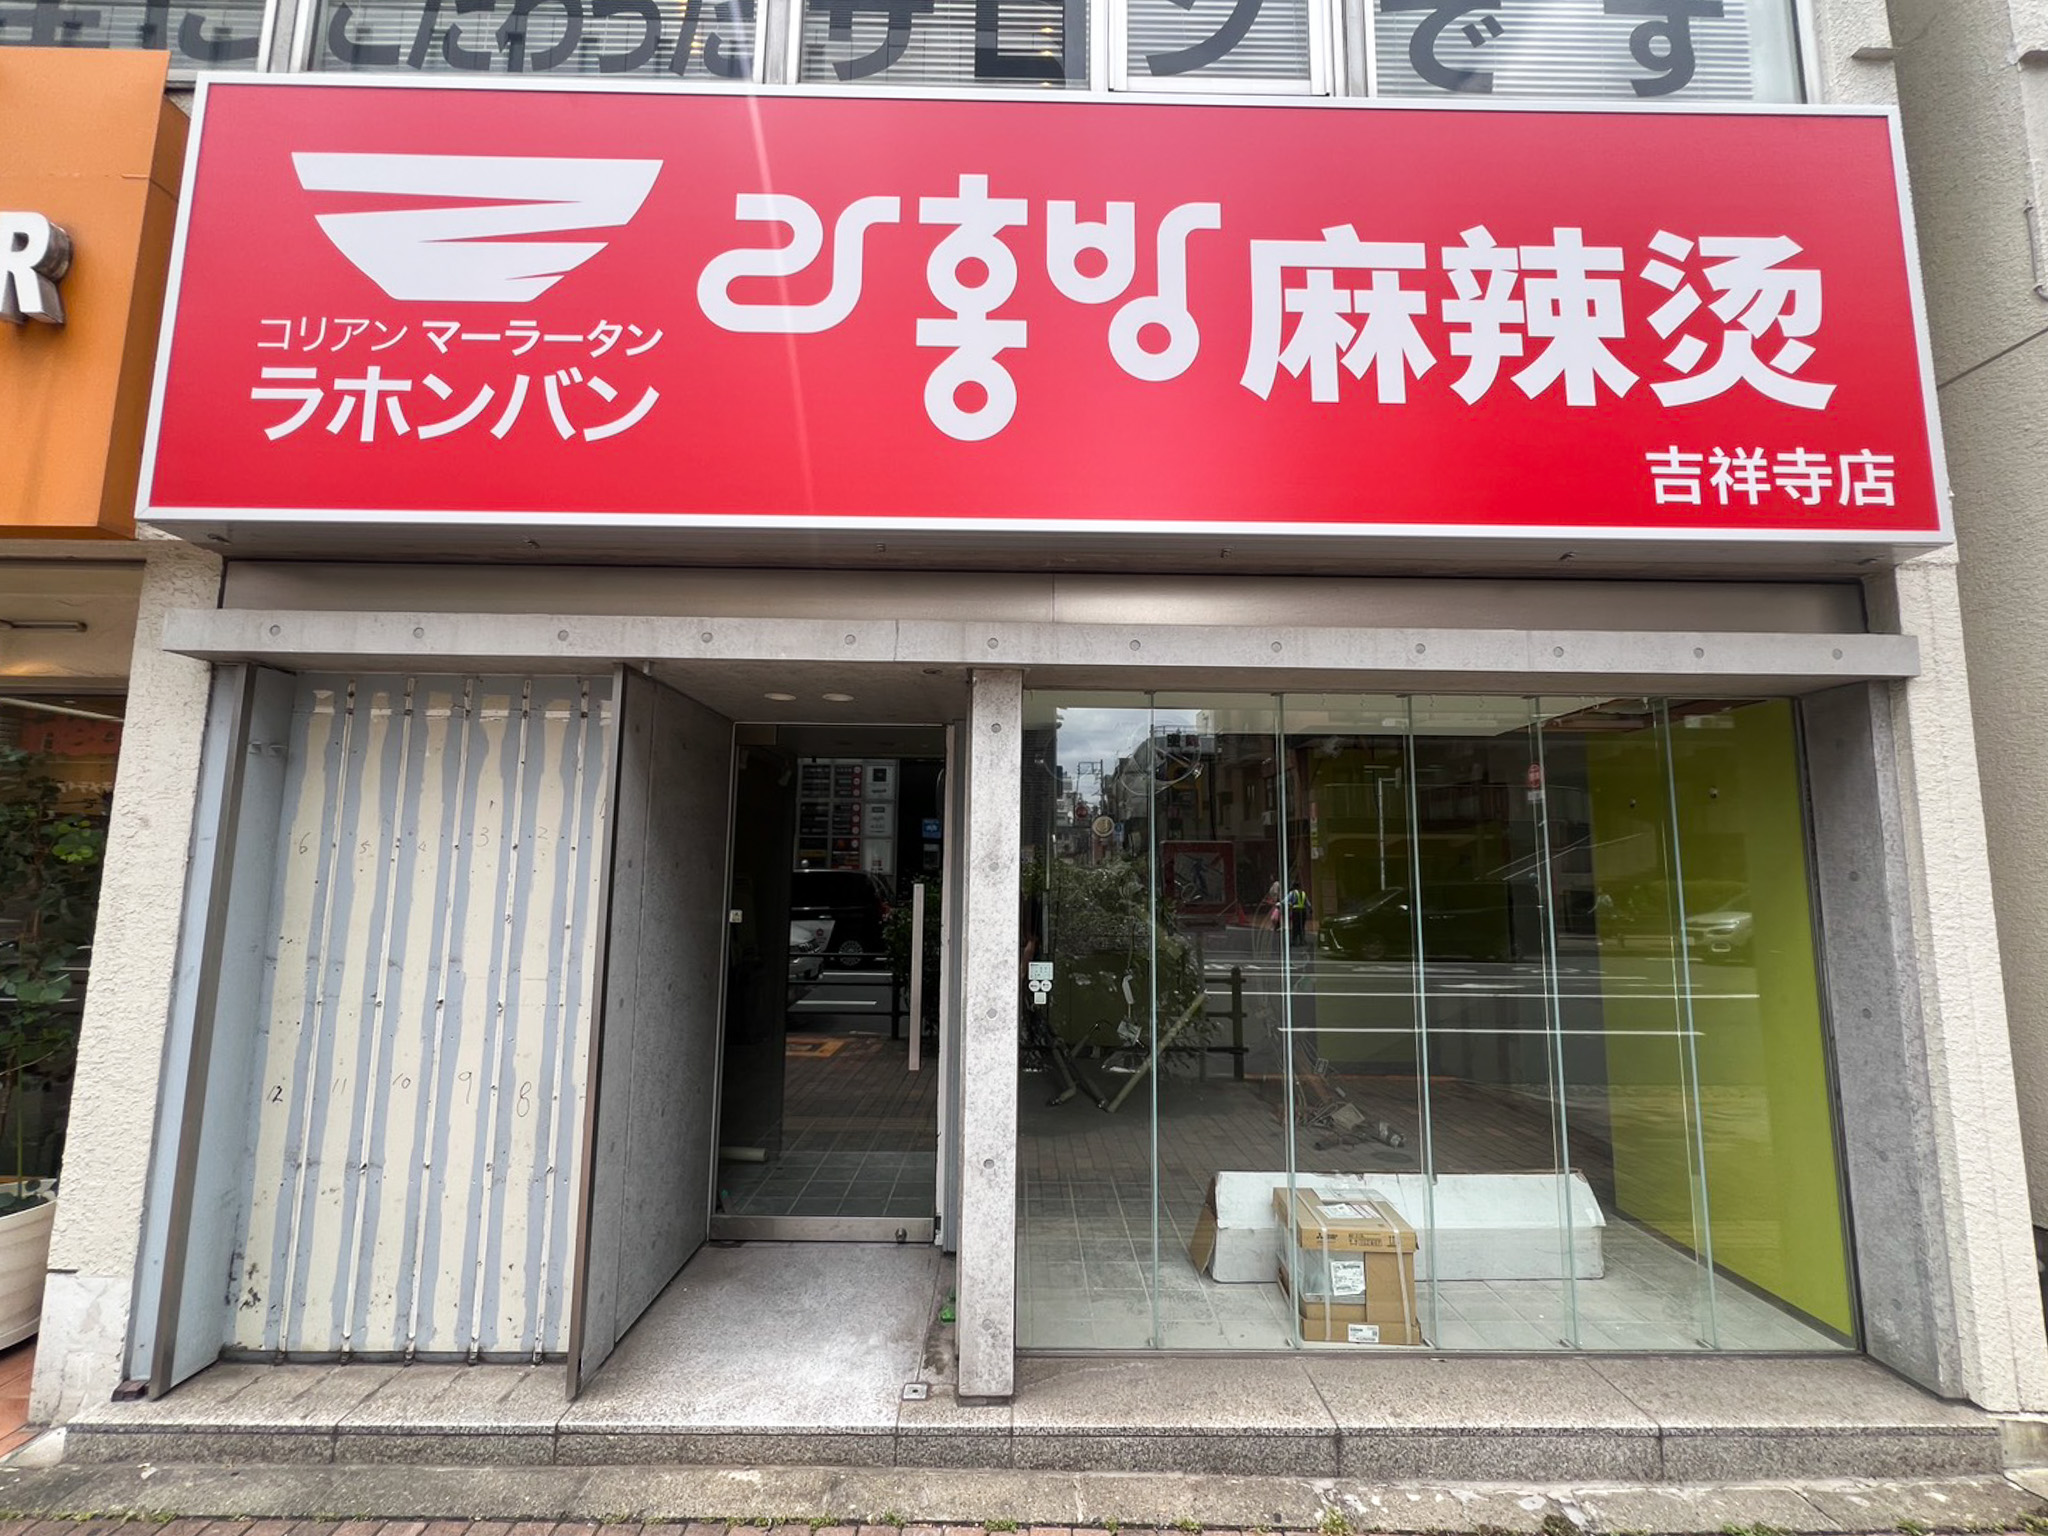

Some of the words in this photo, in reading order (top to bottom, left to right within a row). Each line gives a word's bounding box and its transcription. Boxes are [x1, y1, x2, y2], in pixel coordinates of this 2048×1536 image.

[257, 316, 407, 351] コリアン
[422, 319, 663, 357] マーラータン
[1240, 223, 1837, 410] 麻辣烫
[250, 365, 660, 442] ラホンバン
[1645, 445, 1895, 506] 吉祥寺店
[475, 826, 490, 848] 3
[265, 1084, 284, 1103] 12
[392, 1072, 412, 1090] 10
[457, 1070, 473, 1105] 9
[516, 1081, 532, 1118] 8
